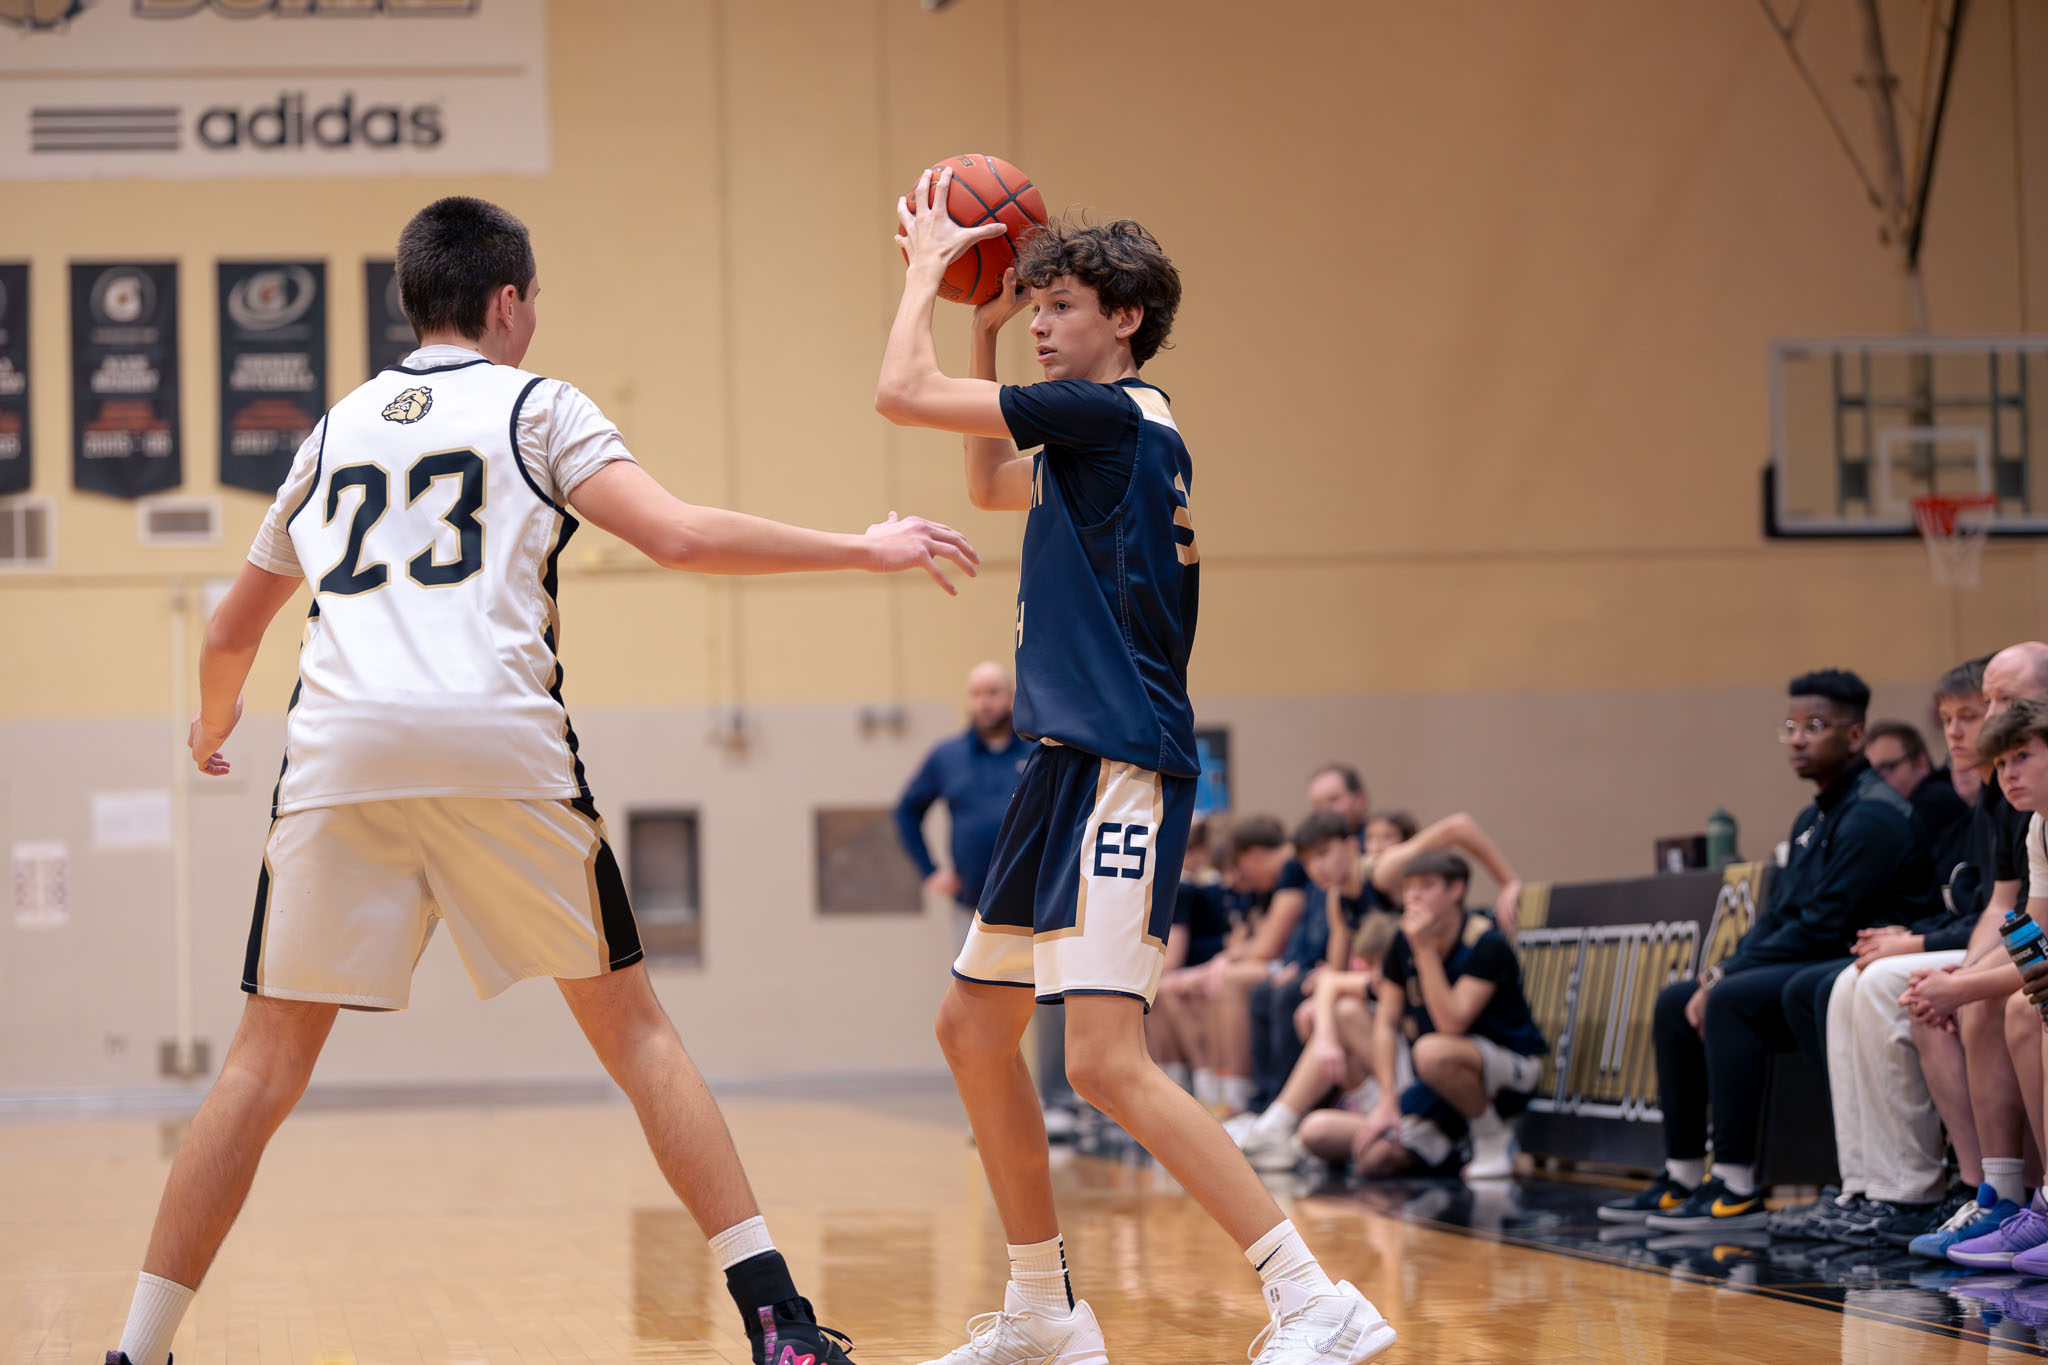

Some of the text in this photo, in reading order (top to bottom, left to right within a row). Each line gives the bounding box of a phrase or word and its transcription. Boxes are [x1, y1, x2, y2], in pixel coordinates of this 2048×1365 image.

[198, 92, 443, 148] adidas
[316, 446, 487, 598] 23
[1093, 822, 1148, 880] ES
